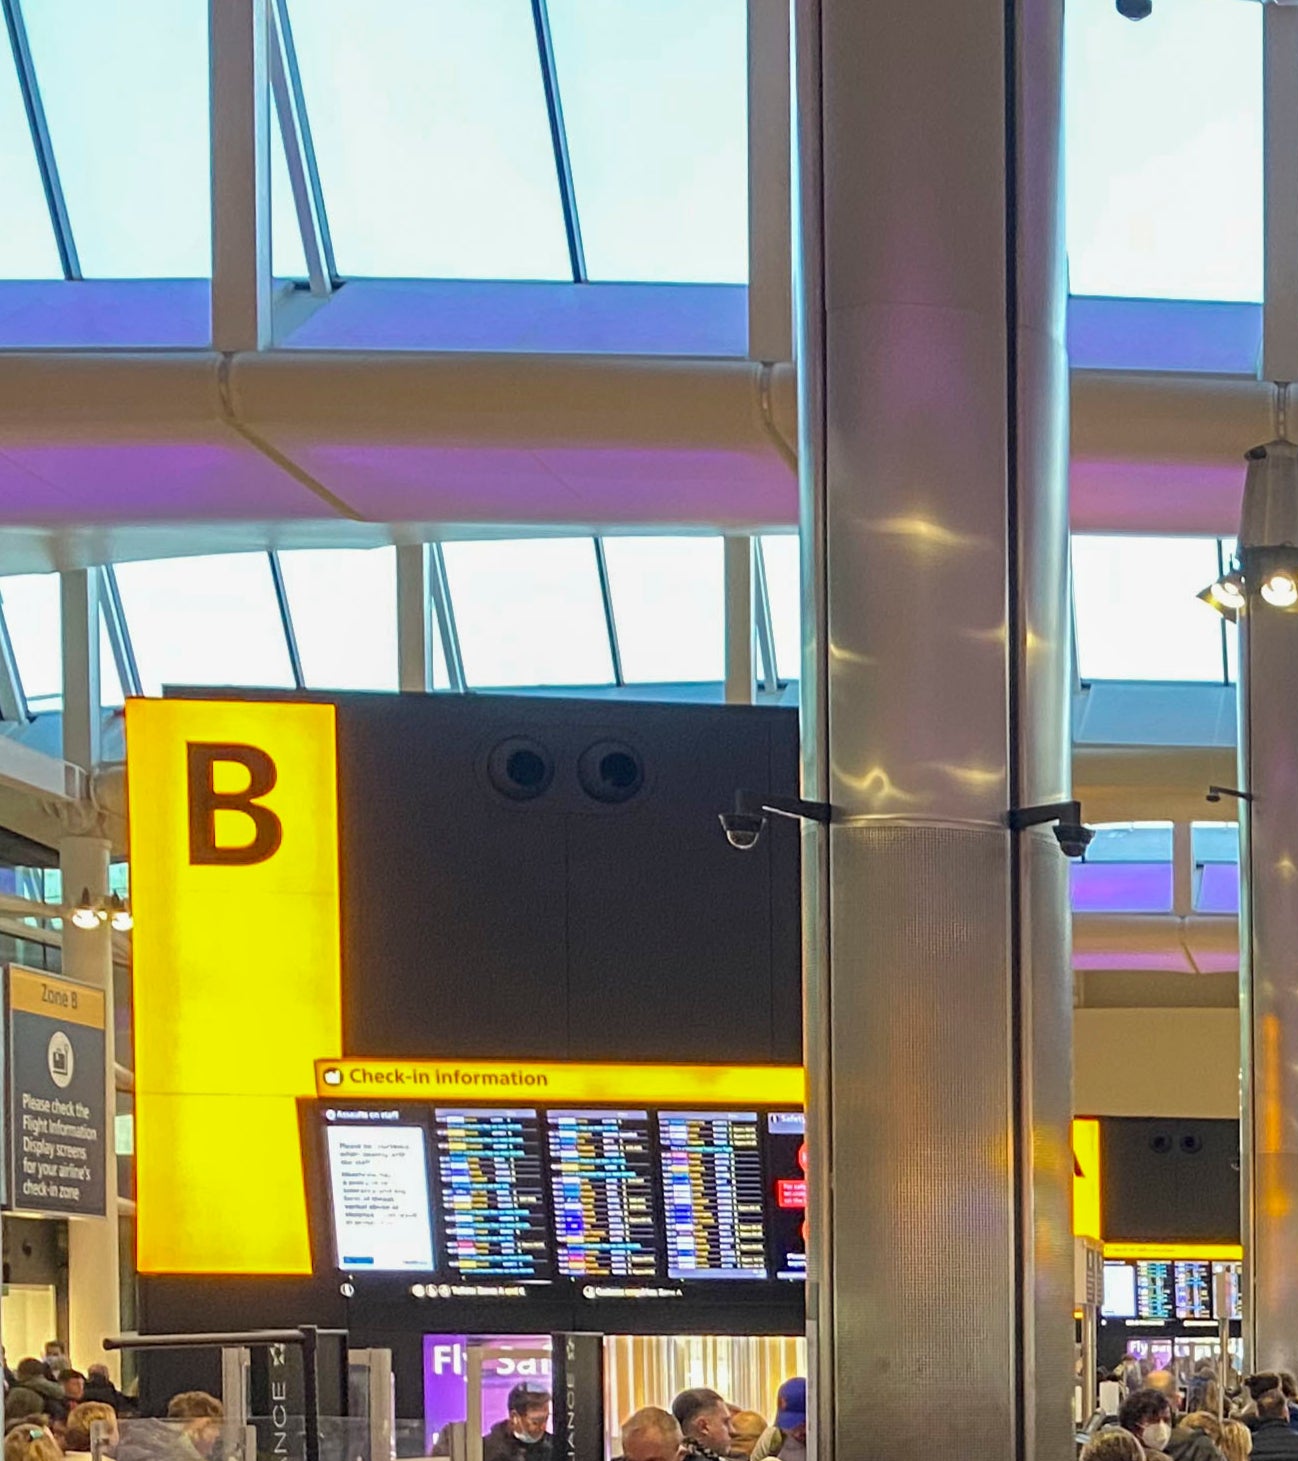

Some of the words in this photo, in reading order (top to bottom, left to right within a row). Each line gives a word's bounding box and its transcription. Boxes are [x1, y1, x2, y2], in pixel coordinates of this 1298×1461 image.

[187, 741, 282, 868] B
[41, 983, 69, 1007] Zone
[350, 1069, 430, 1084] Check-in
[435, 1069, 548, 1086] information
[22, 1092, 50, 1113] Please
[51, 1098, 75, 1117] check
[75, 1102, 90, 1119] the
[23, 1114, 48, 1137] Flight
[49, 1119, 97, 1140] Information
[23, 1136, 55, 1159] Display
[56, 1144, 88, 1160] screens
[23, 1156, 36, 1174] for
[37, 1162, 58, 1179] your
[58, 1161, 91, 1181] airline's
[23, 1178, 58, 1197] check-in
[59, 1185, 80, 1201] zone
